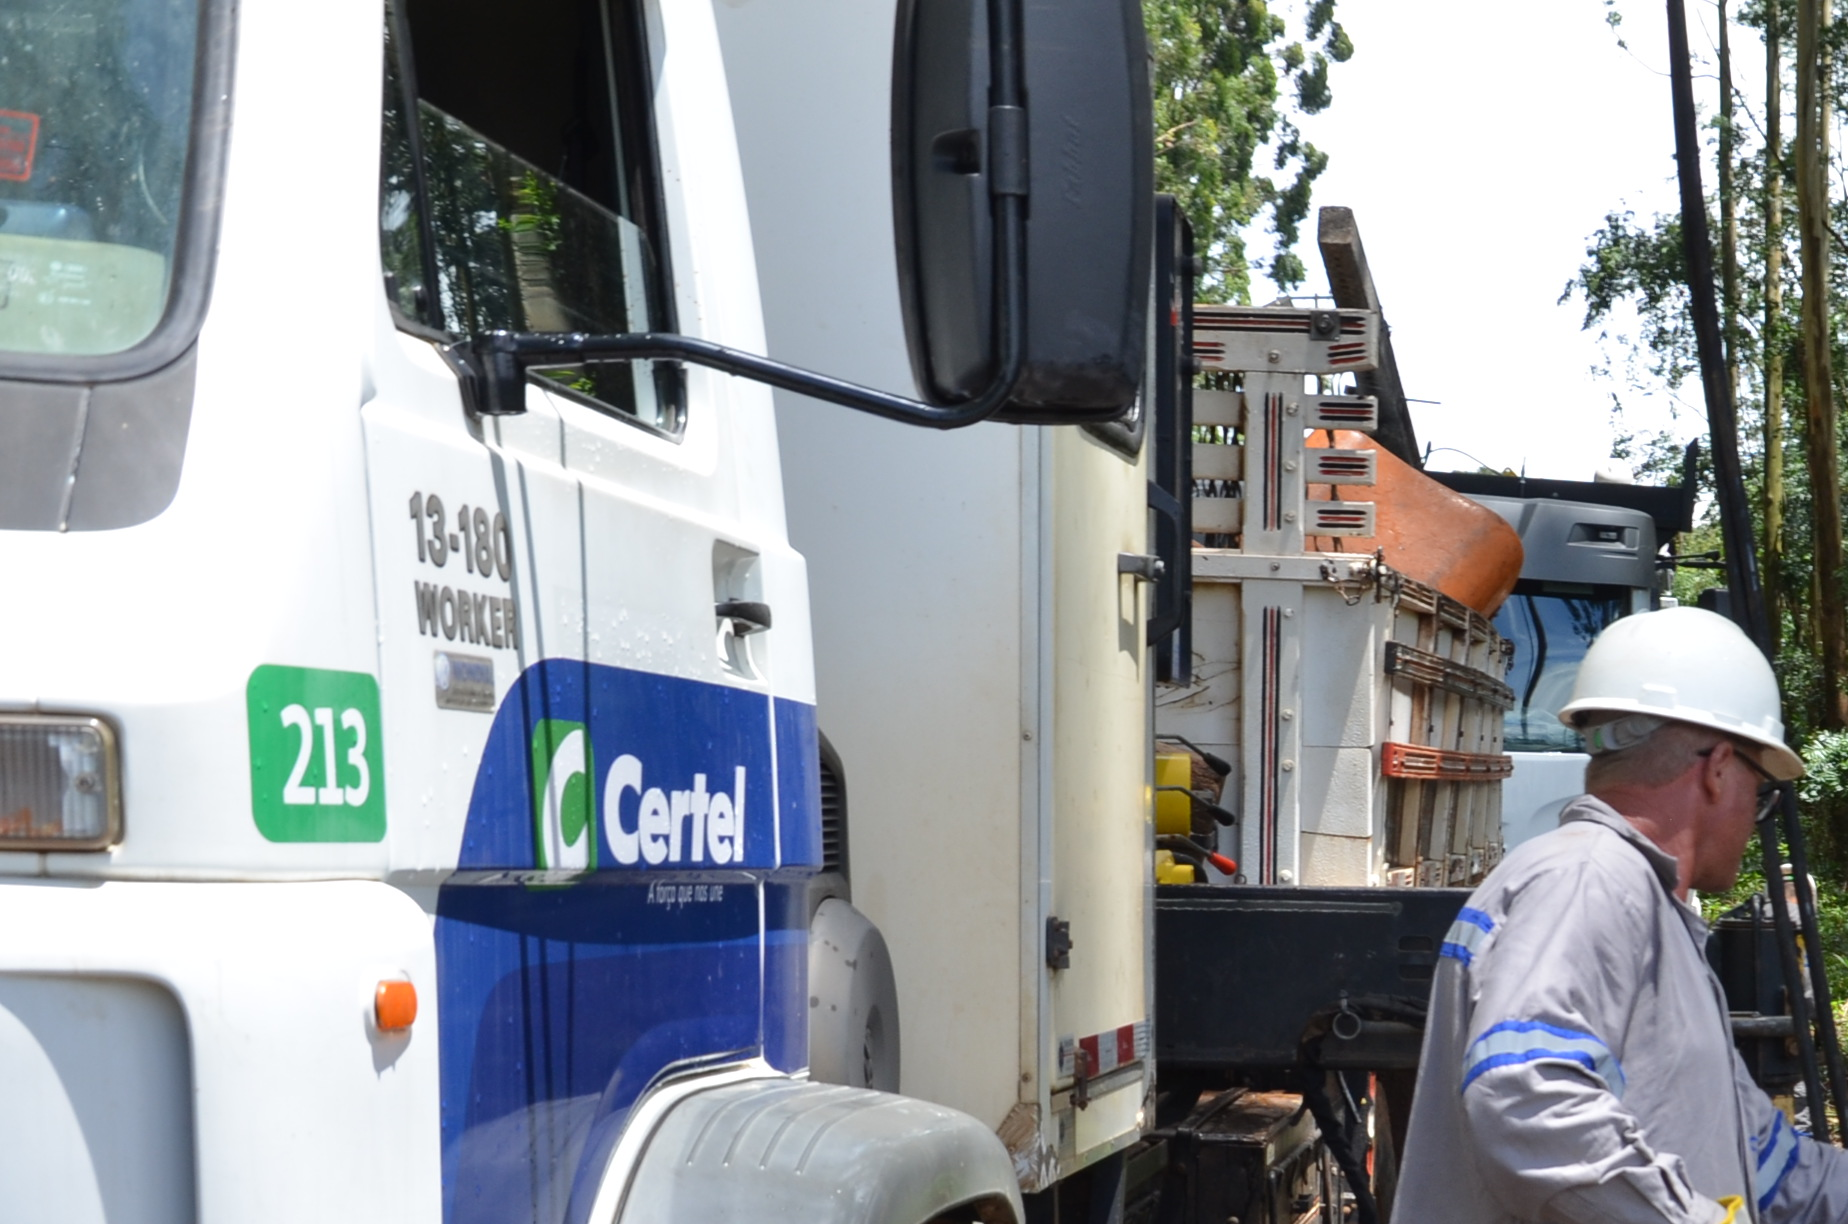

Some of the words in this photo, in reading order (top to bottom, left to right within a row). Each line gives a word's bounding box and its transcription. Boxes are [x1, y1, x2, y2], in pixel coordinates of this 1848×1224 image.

[409, 491, 512, 582] 13-180
[414, 579, 519, 650] WORKER
[280, 703, 370, 807] 213
[603, 753, 746, 866] Certel
